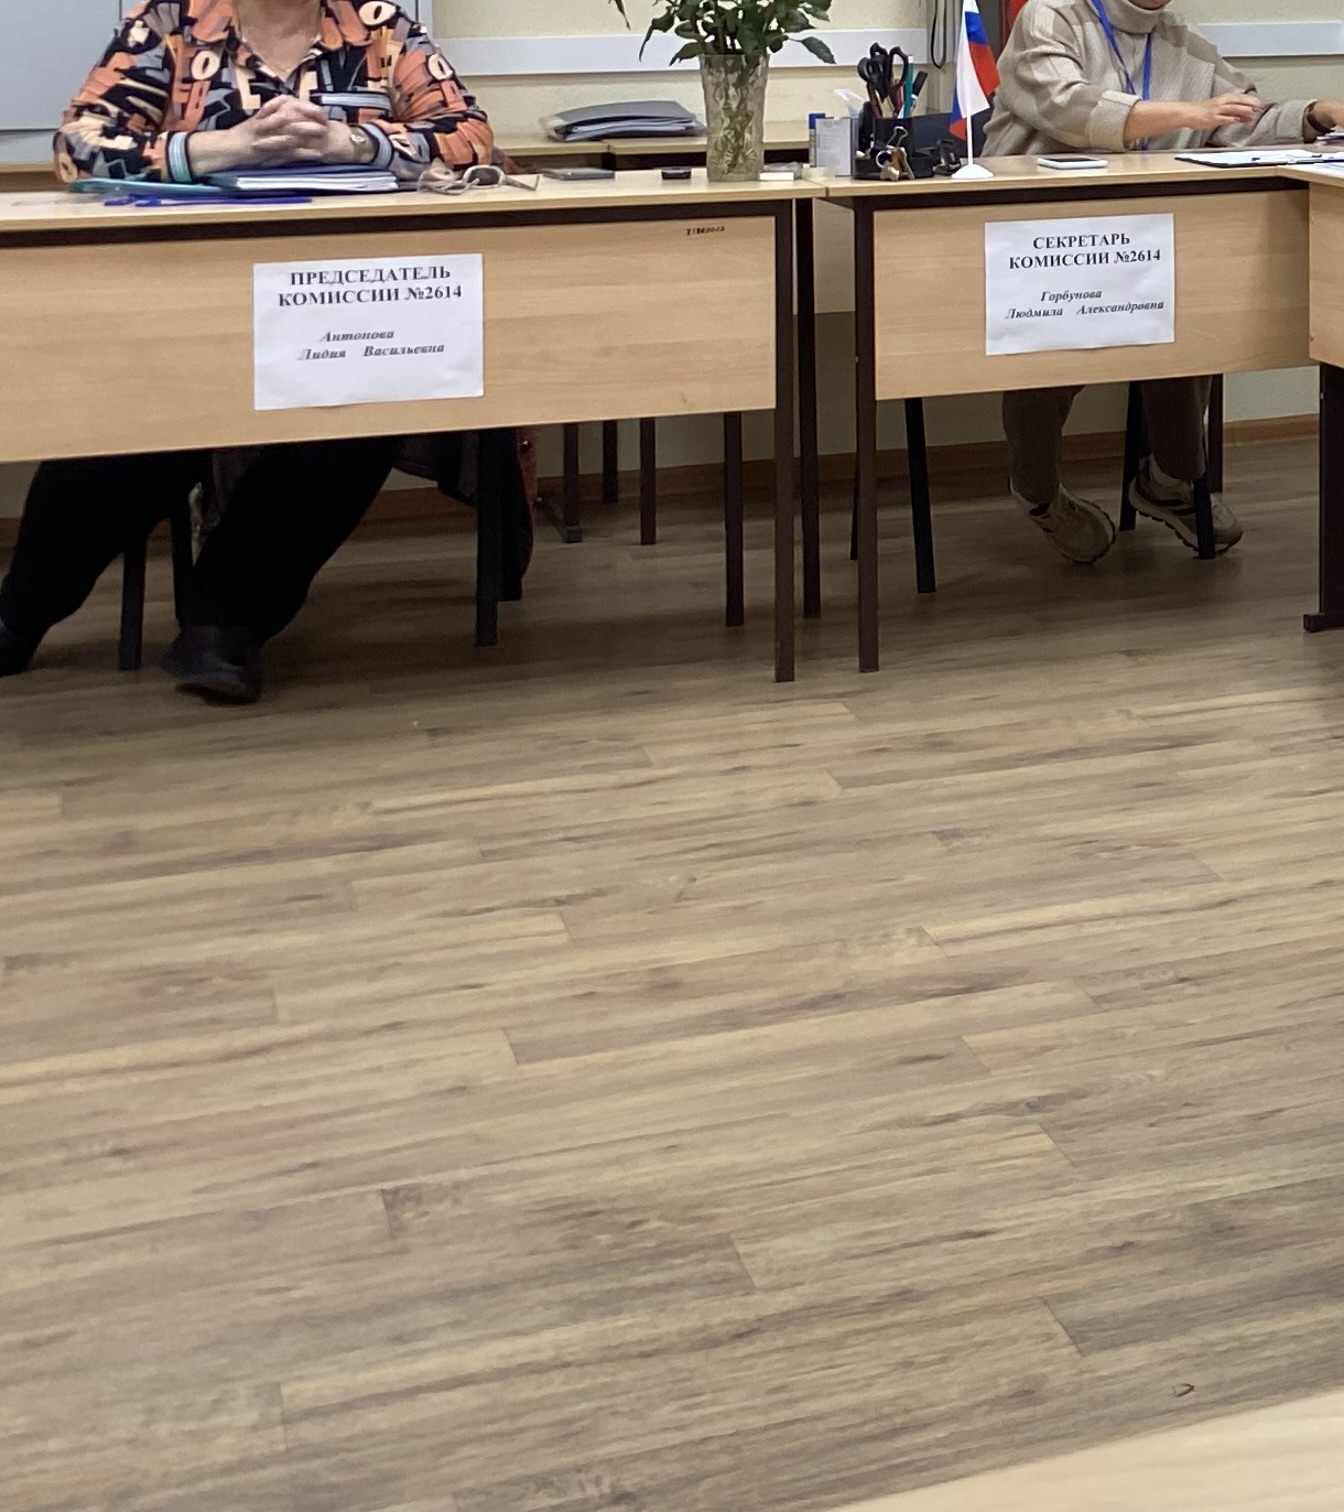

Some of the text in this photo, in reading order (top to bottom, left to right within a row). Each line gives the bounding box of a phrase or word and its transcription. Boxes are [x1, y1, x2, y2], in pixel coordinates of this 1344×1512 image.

[1032, 233, 1130, 250] СЕКРЕТАРЬ
[1009, 249, 1161, 270] КОМИССИИ №2614
[290, 266, 451, 286] ПРЕДСЕДАТЕЛЬ
[278, 285, 462, 307] КОМИССИИ №2614
[1040, 290, 1102, 304] Горбунова
[1005, 301, 1164, 320] Людмила Александровна
[319, 330, 395, 343] Антонова
[296, 343, 445, 361] Лидия Васильевна
